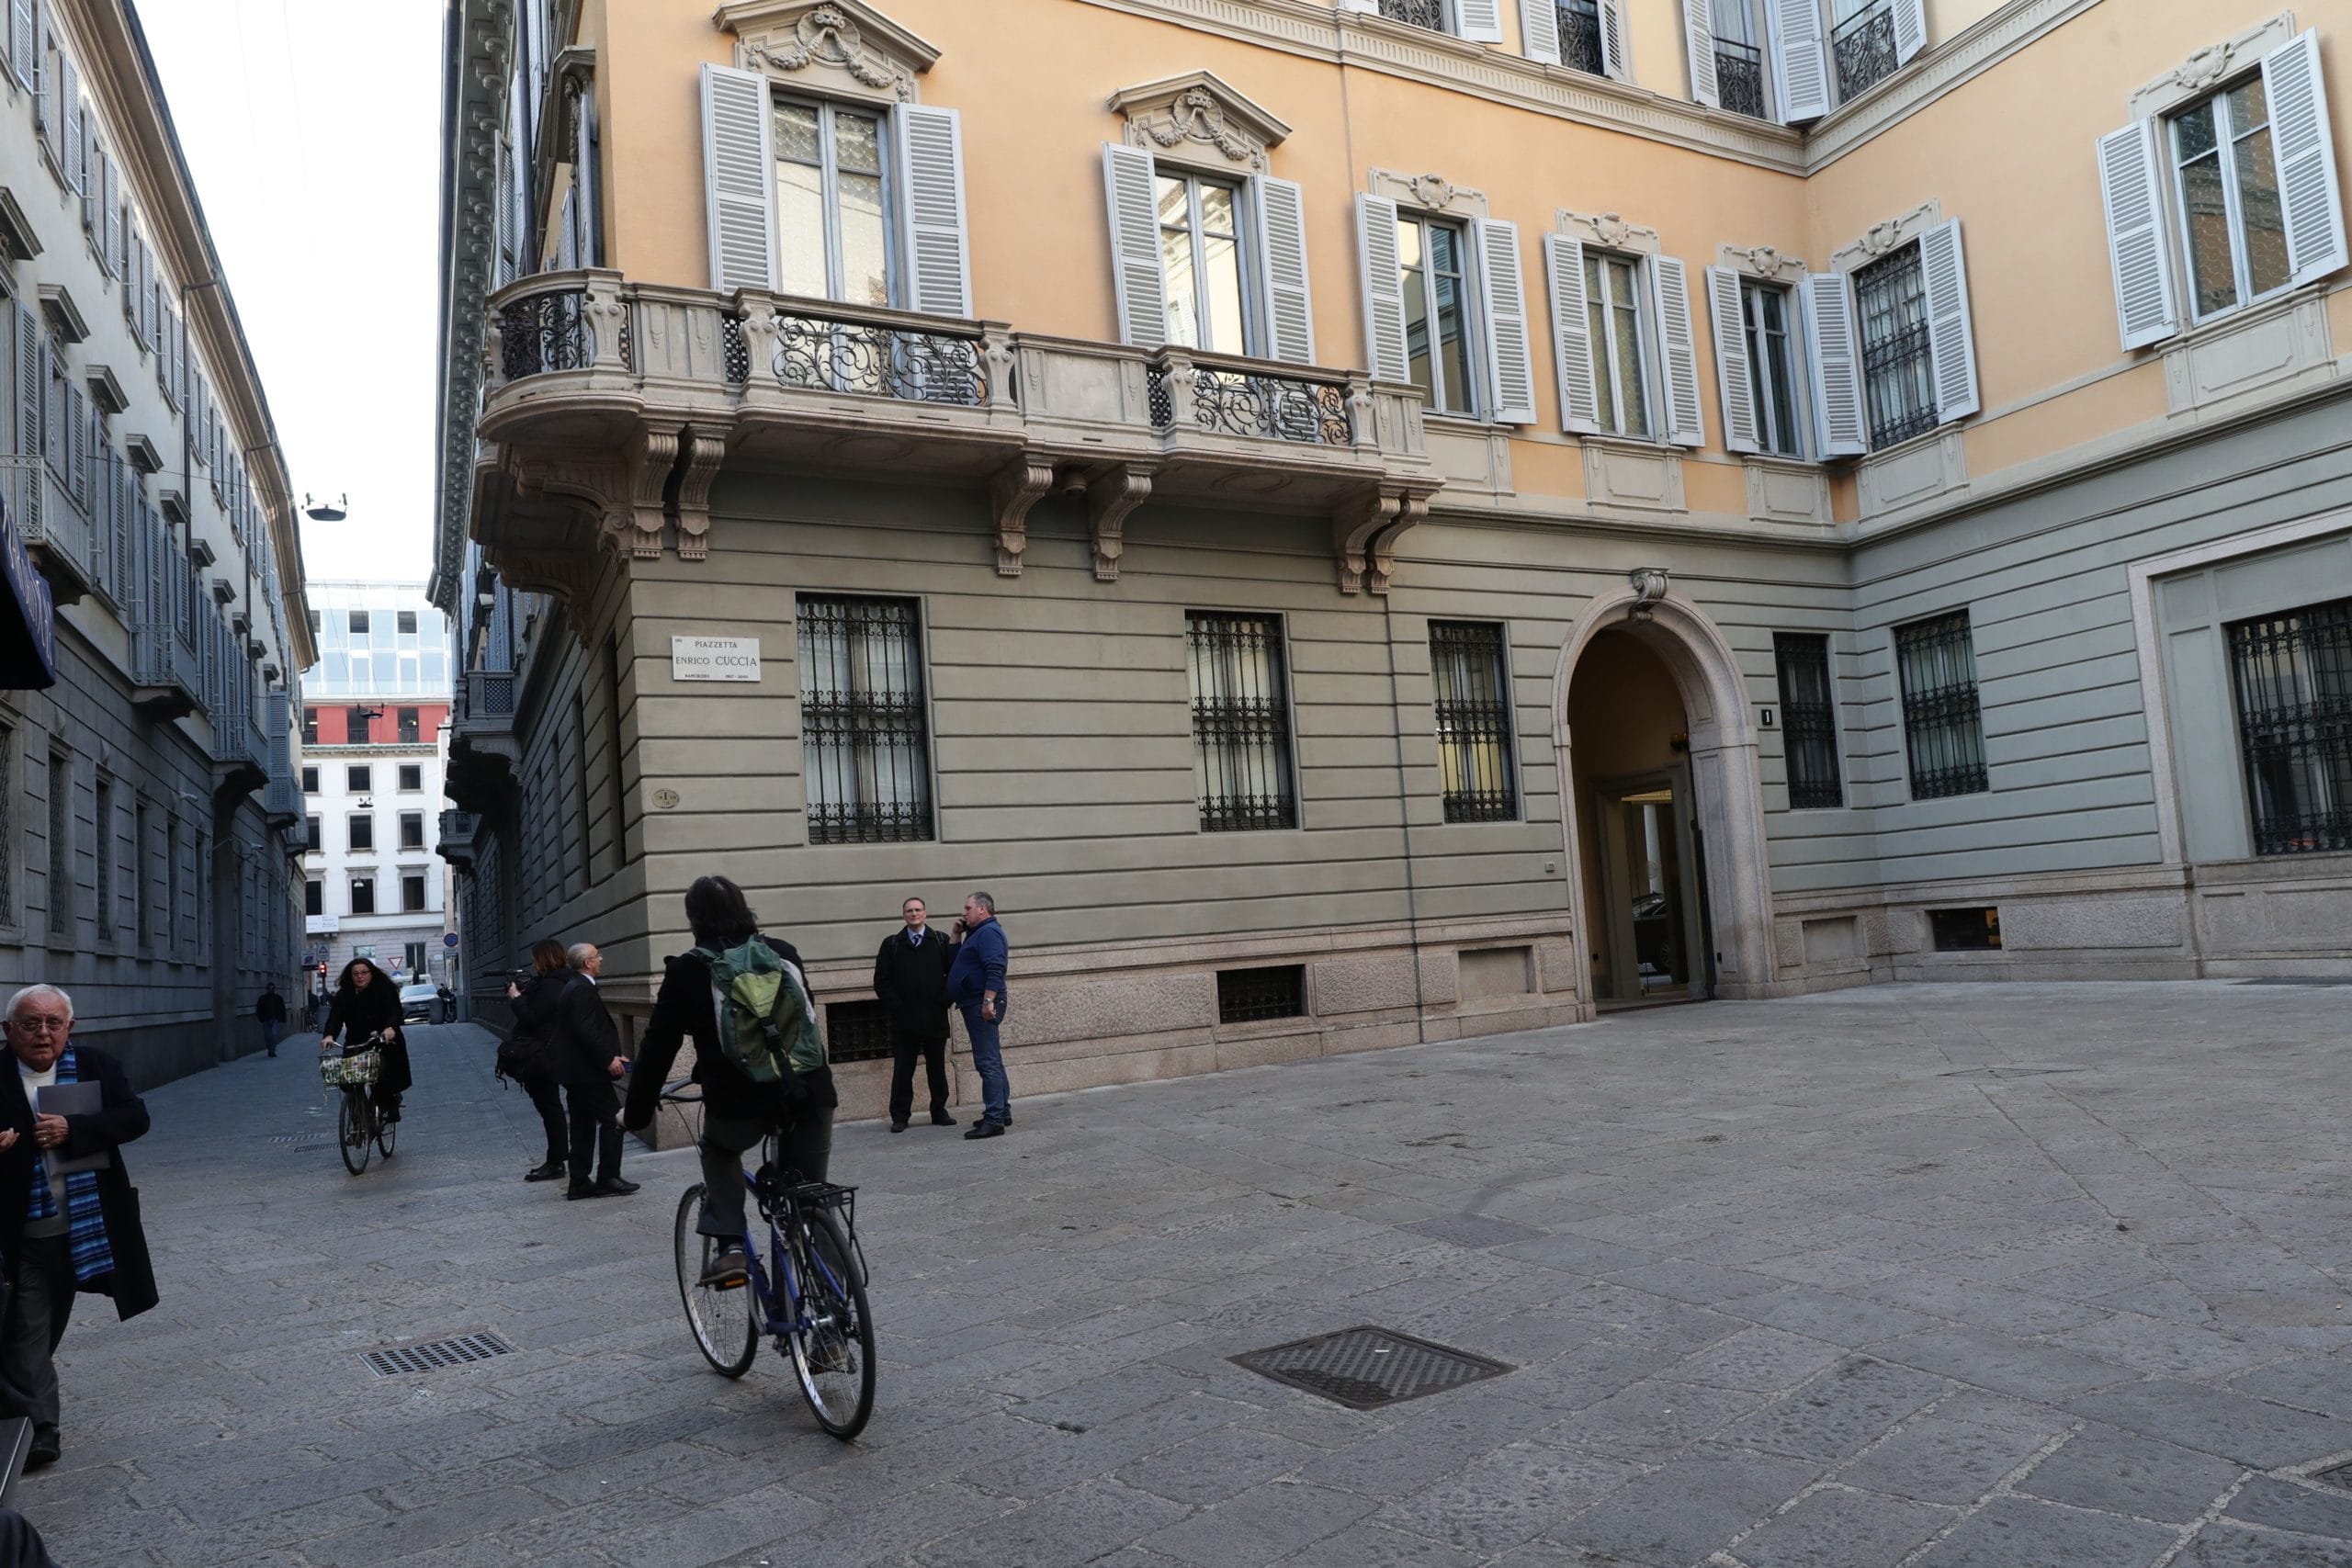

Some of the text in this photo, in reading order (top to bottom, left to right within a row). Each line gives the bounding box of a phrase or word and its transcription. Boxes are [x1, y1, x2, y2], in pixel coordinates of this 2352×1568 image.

[675, 656, 757, 667] ENRICO CUCCIA
[1765, 711, 1770, 723] 1
